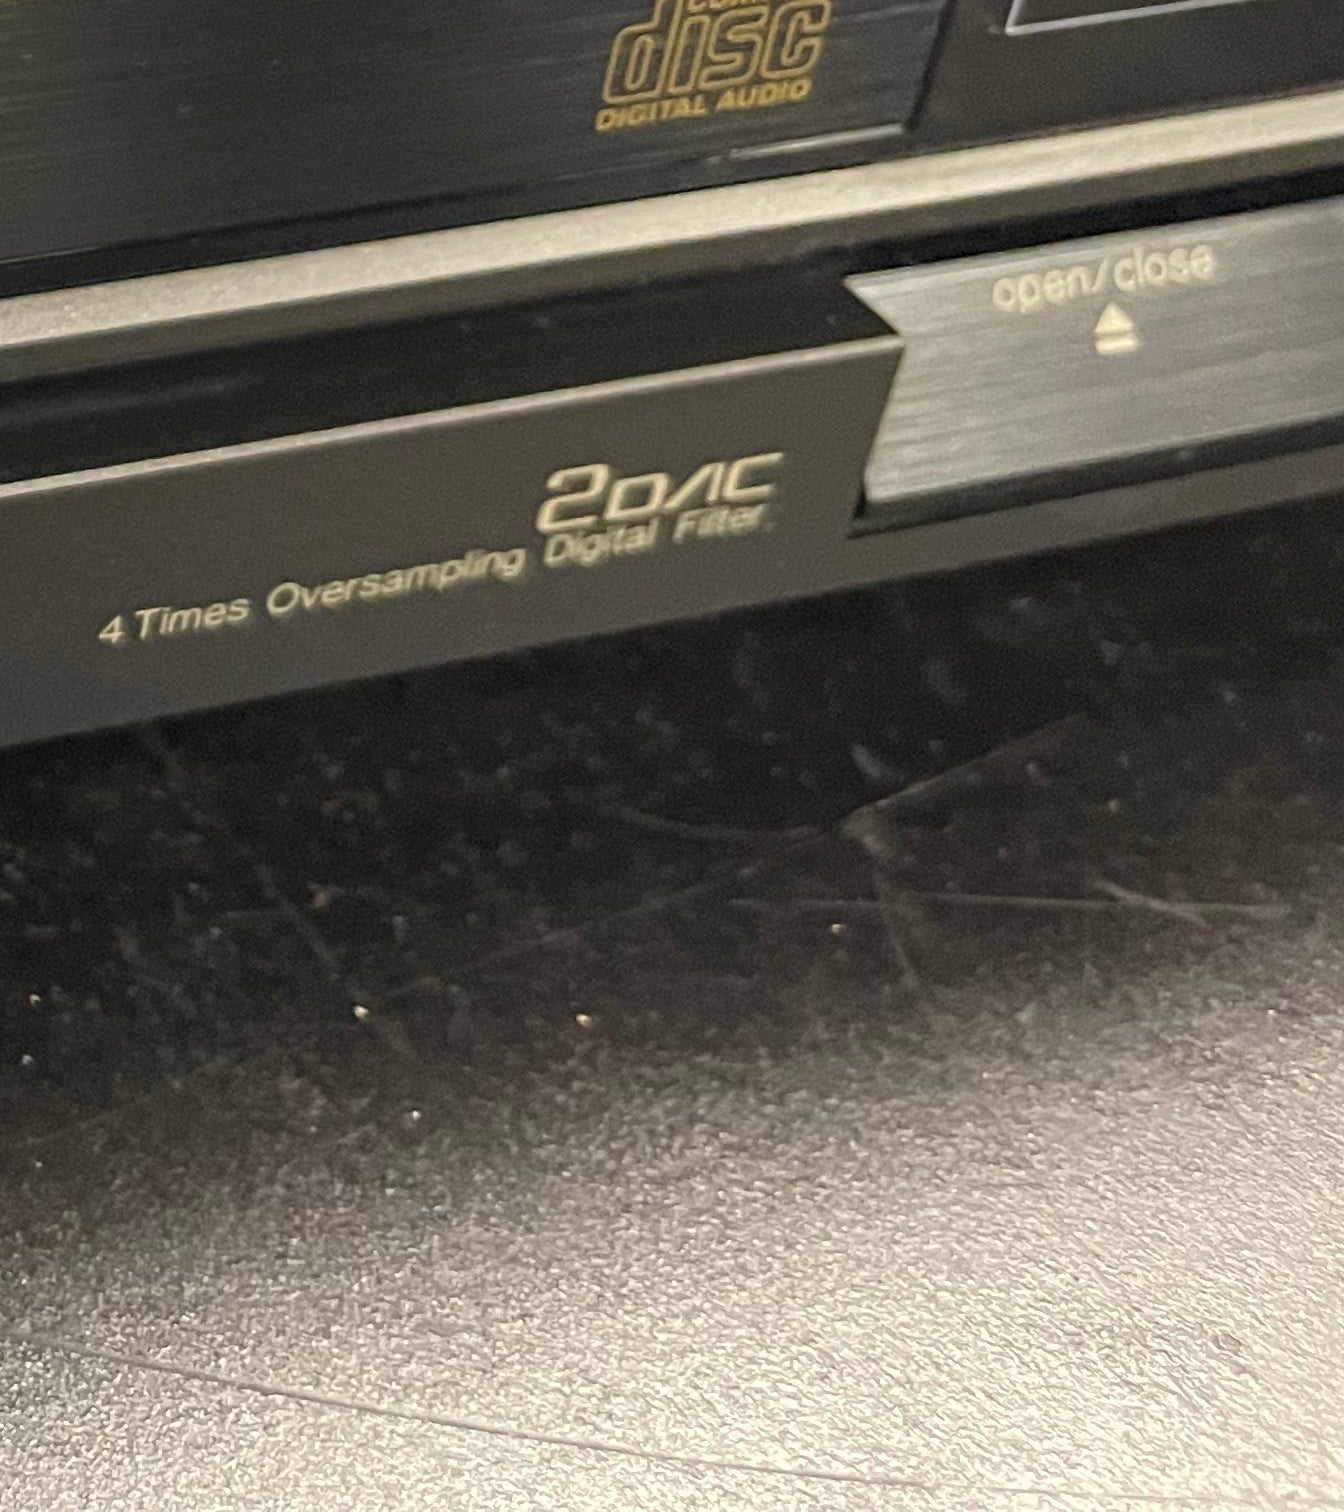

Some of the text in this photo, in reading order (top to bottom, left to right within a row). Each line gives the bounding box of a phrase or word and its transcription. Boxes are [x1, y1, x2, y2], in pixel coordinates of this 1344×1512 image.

[595, 77, 814, 132] DIGITAL AUDIO
[992, 244, 1216, 314] open/close
[98, 503, 768, 645] 4 Times Oversampling Digital Filter
